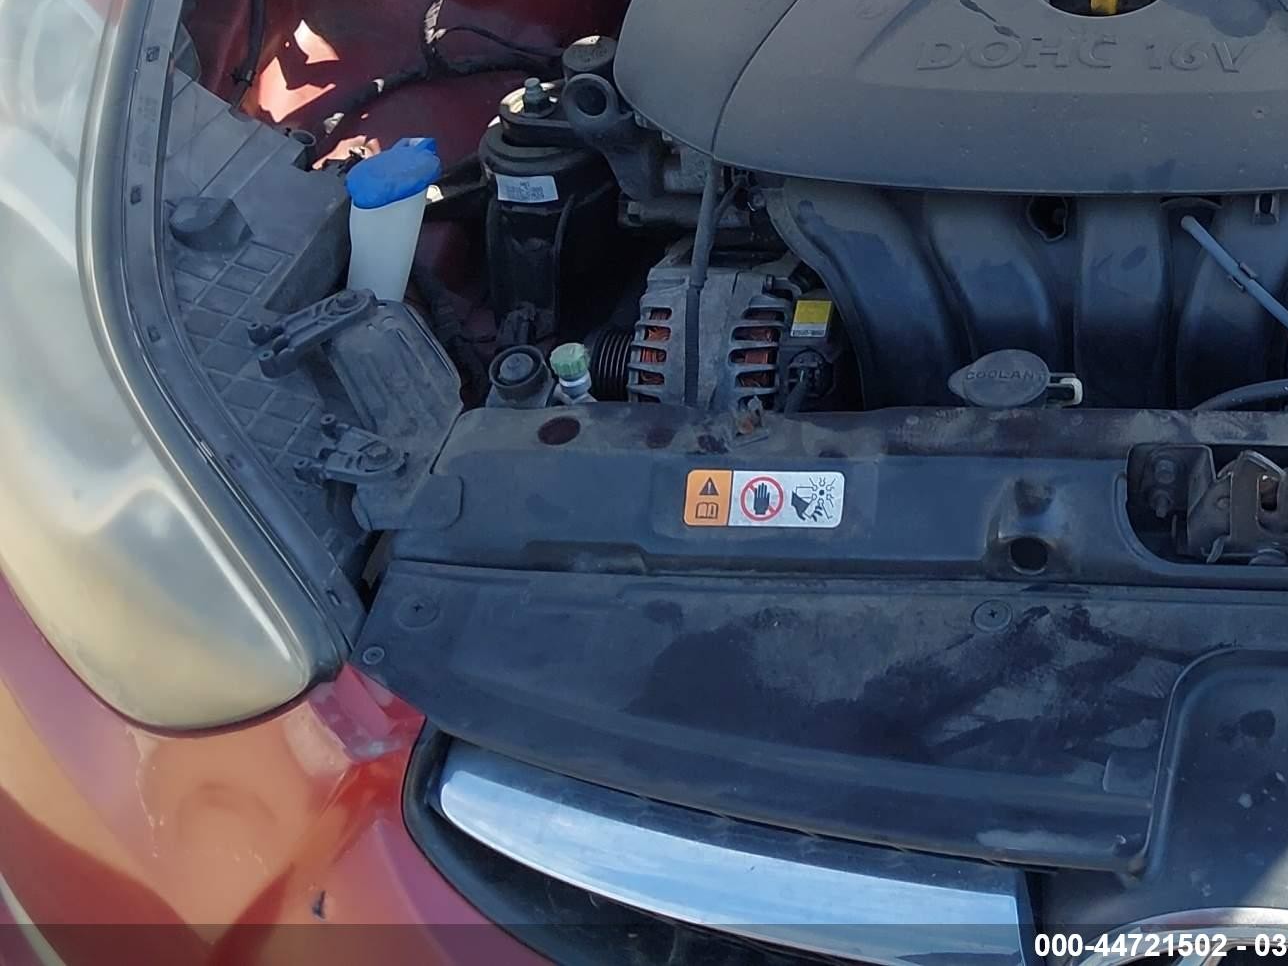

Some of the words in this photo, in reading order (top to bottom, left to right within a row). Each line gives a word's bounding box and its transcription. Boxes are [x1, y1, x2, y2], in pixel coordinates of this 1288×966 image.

[915, 37, 1117, 71] DOHC
[1142, 40, 1249, 74] 16V
[966, 369, 1044, 381] COOLANT
